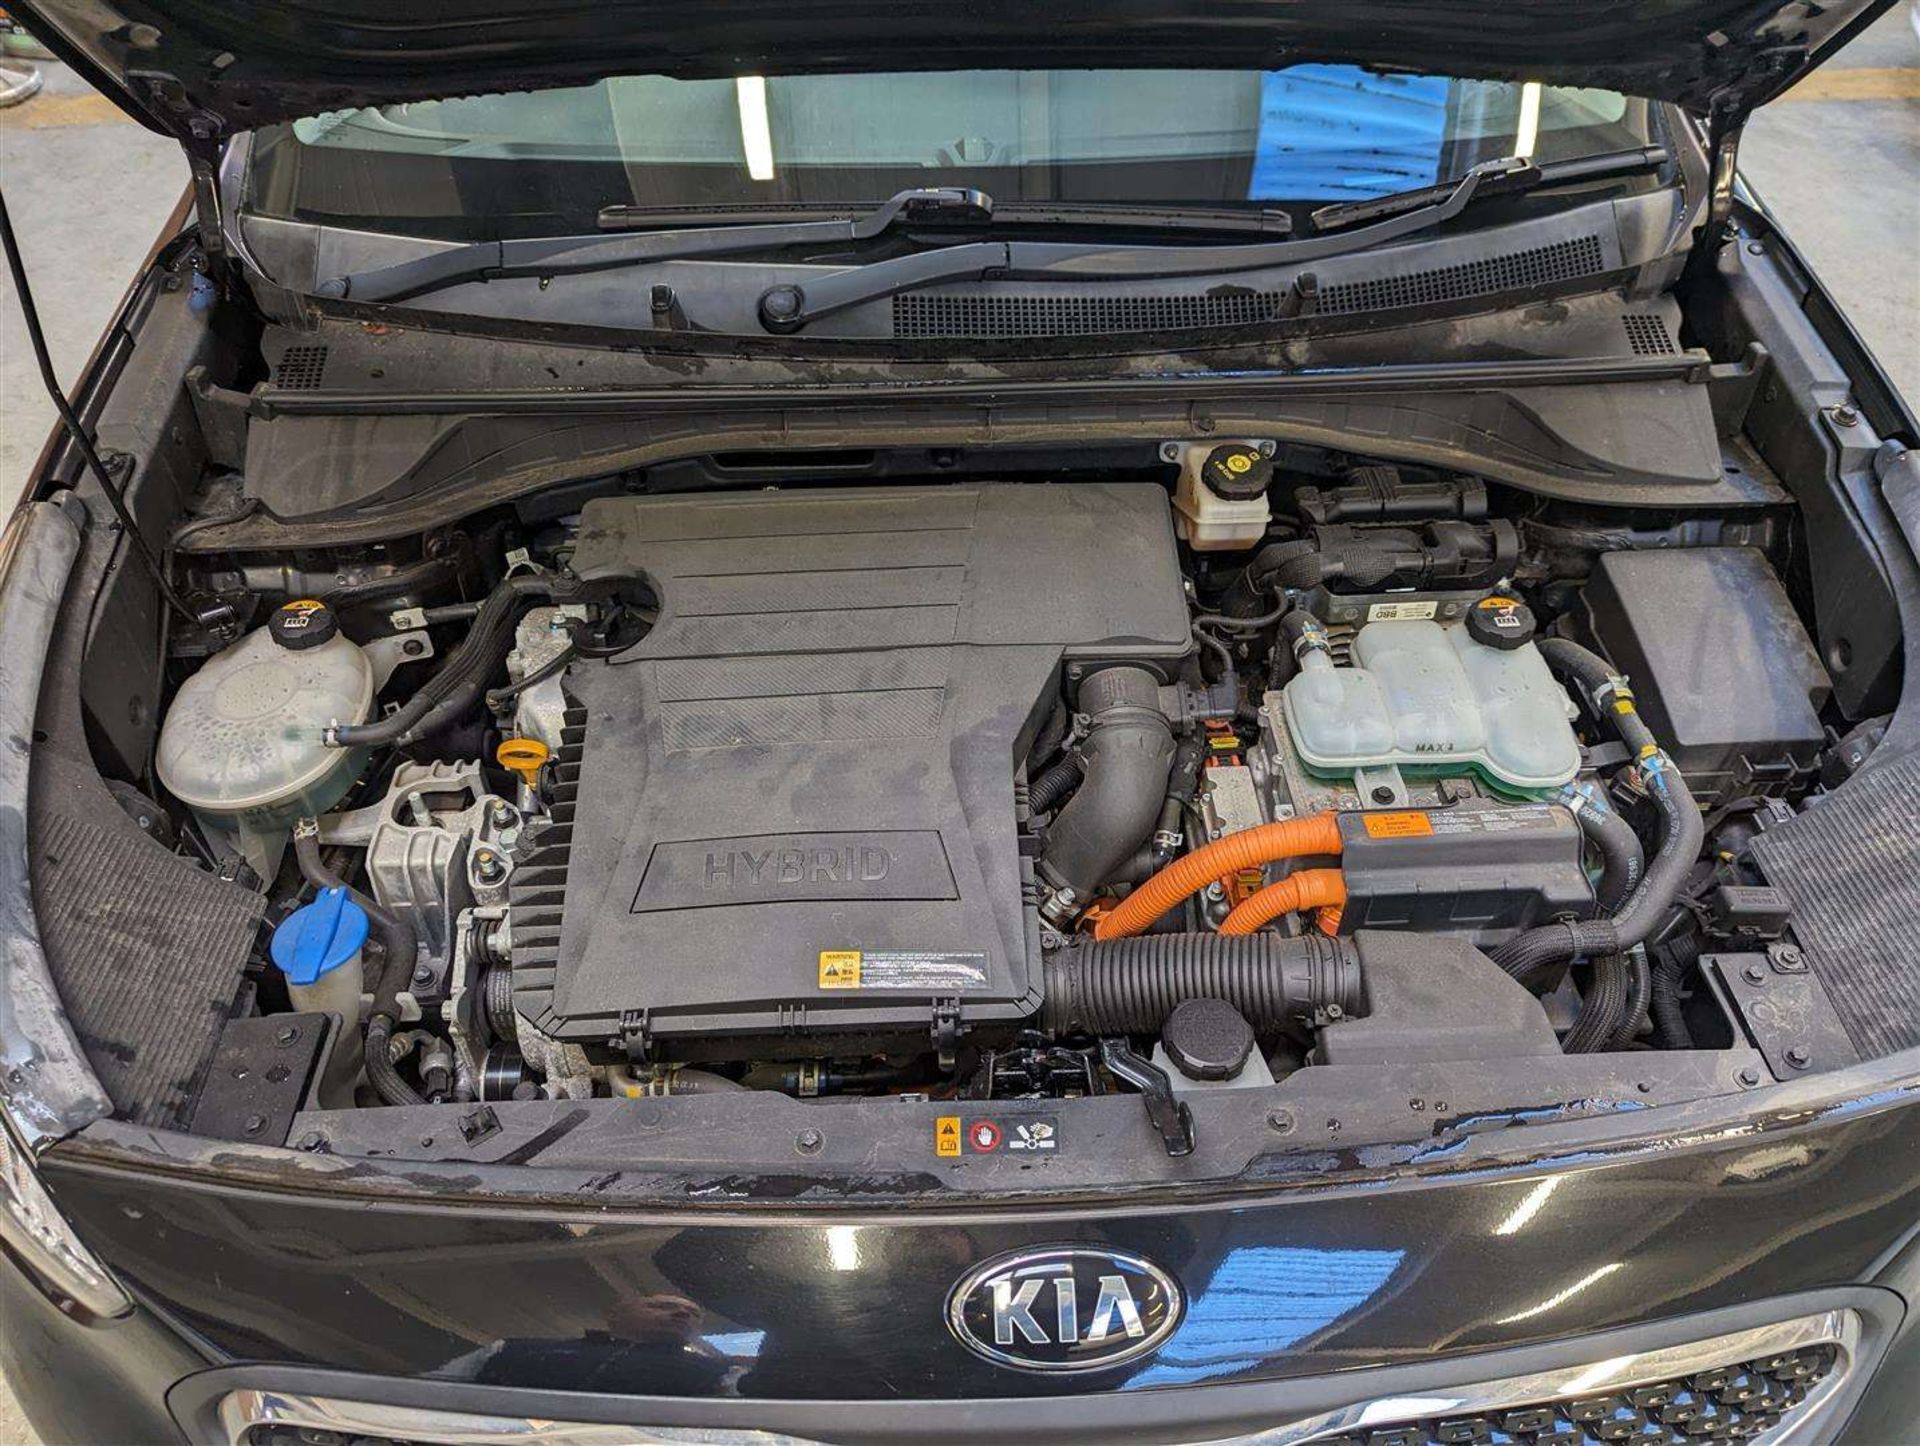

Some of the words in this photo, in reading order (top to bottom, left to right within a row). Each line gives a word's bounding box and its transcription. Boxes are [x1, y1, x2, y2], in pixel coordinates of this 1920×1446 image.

[1415, 743, 1444, 752] MAX
[702, 847, 890, 889] HYBRID
[984, 1275, 1145, 1345] KIA
